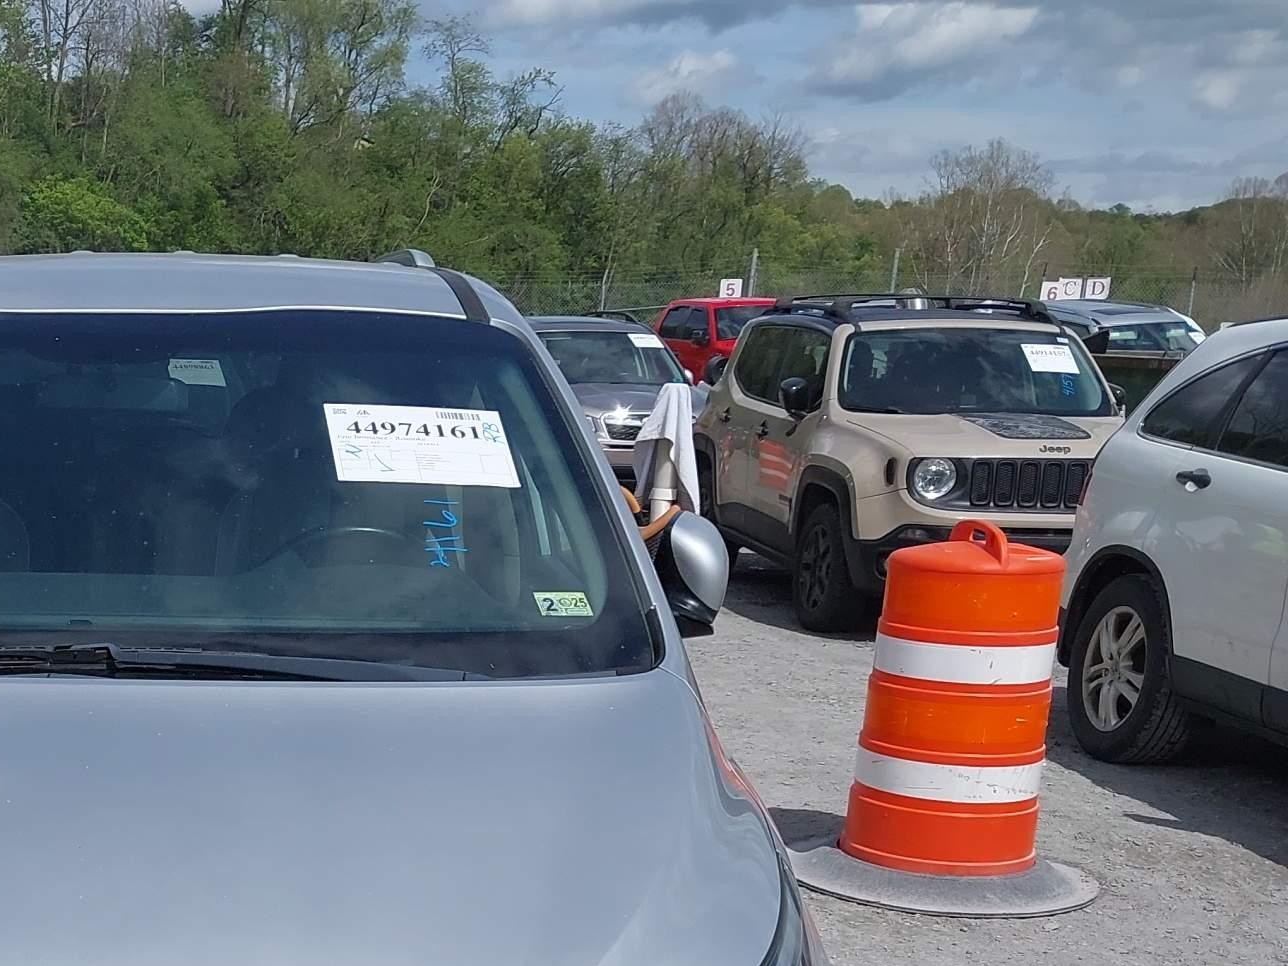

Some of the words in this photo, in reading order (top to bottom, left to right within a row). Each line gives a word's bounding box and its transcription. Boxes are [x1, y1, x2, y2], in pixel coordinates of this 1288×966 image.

[725, 282, 736, 297] 5
[1047, 286, 1059, 301] 6
[1091, 280, 1106, 297] D
[346, 420, 482, 440] 44974161
[1039, 444, 1071, 455] Jeep
[542, 597, 559, 612] 2
[571, 597, 588, 608] 25
